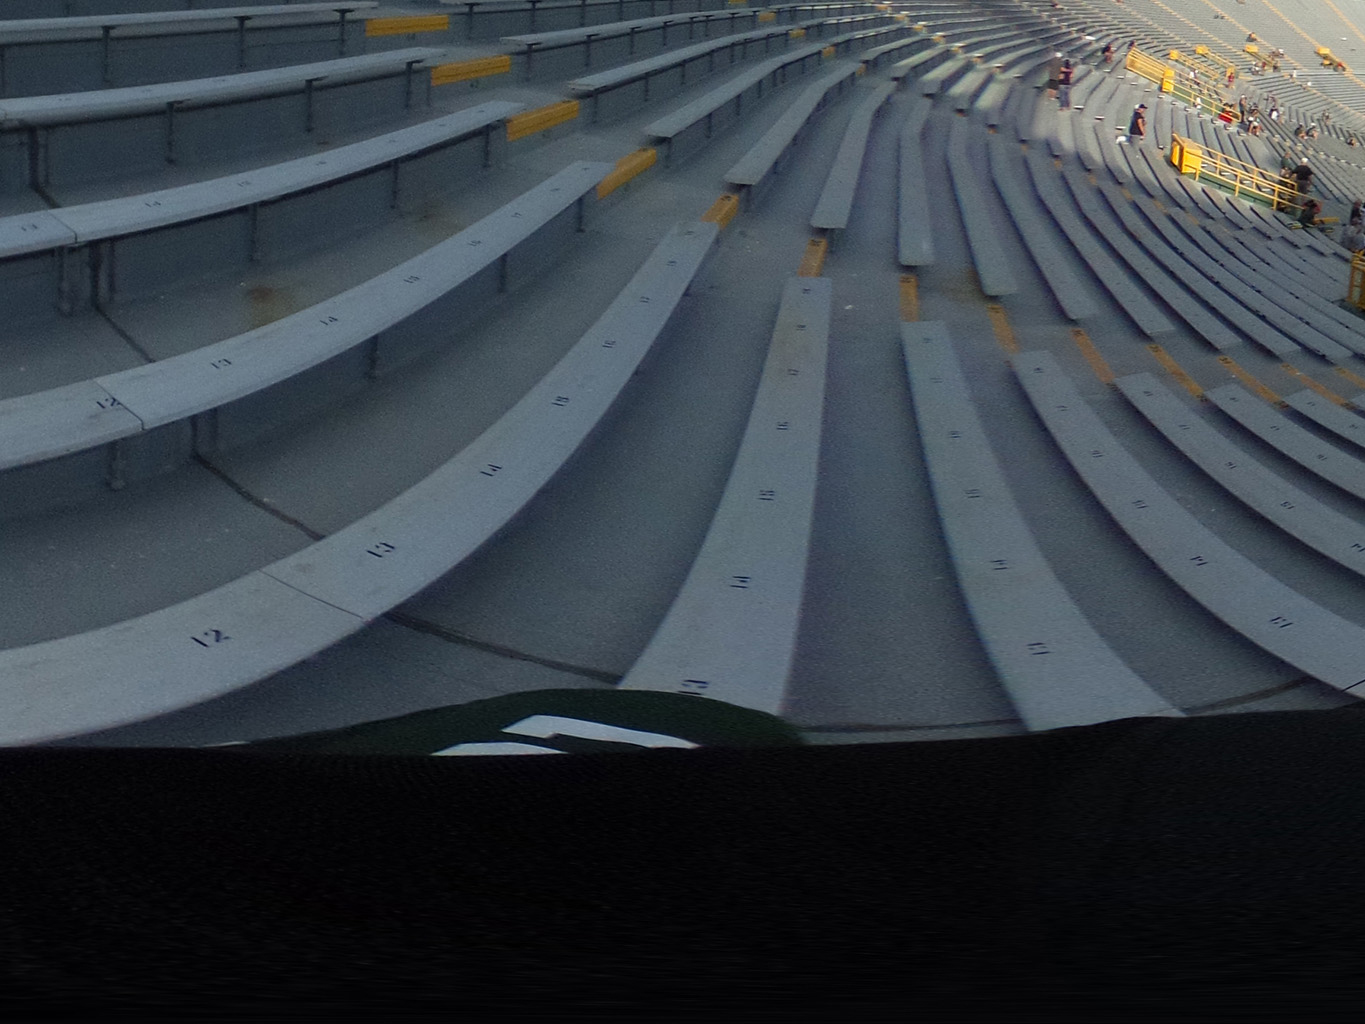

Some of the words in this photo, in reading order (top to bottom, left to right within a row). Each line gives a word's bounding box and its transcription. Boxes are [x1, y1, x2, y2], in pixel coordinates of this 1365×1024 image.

[320, 316, 338, 326] 14
[210, 358, 232, 369] 13
[96, 397, 122, 409] 12
[479, 464, 503, 477] 14
[366, 542, 396, 558] 13
[1269, 616, 1293, 628] 13
[190, 628, 232, 648] 12
[1027, 642, 1051, 655] 13
[677, 679, 711, 695] 13
